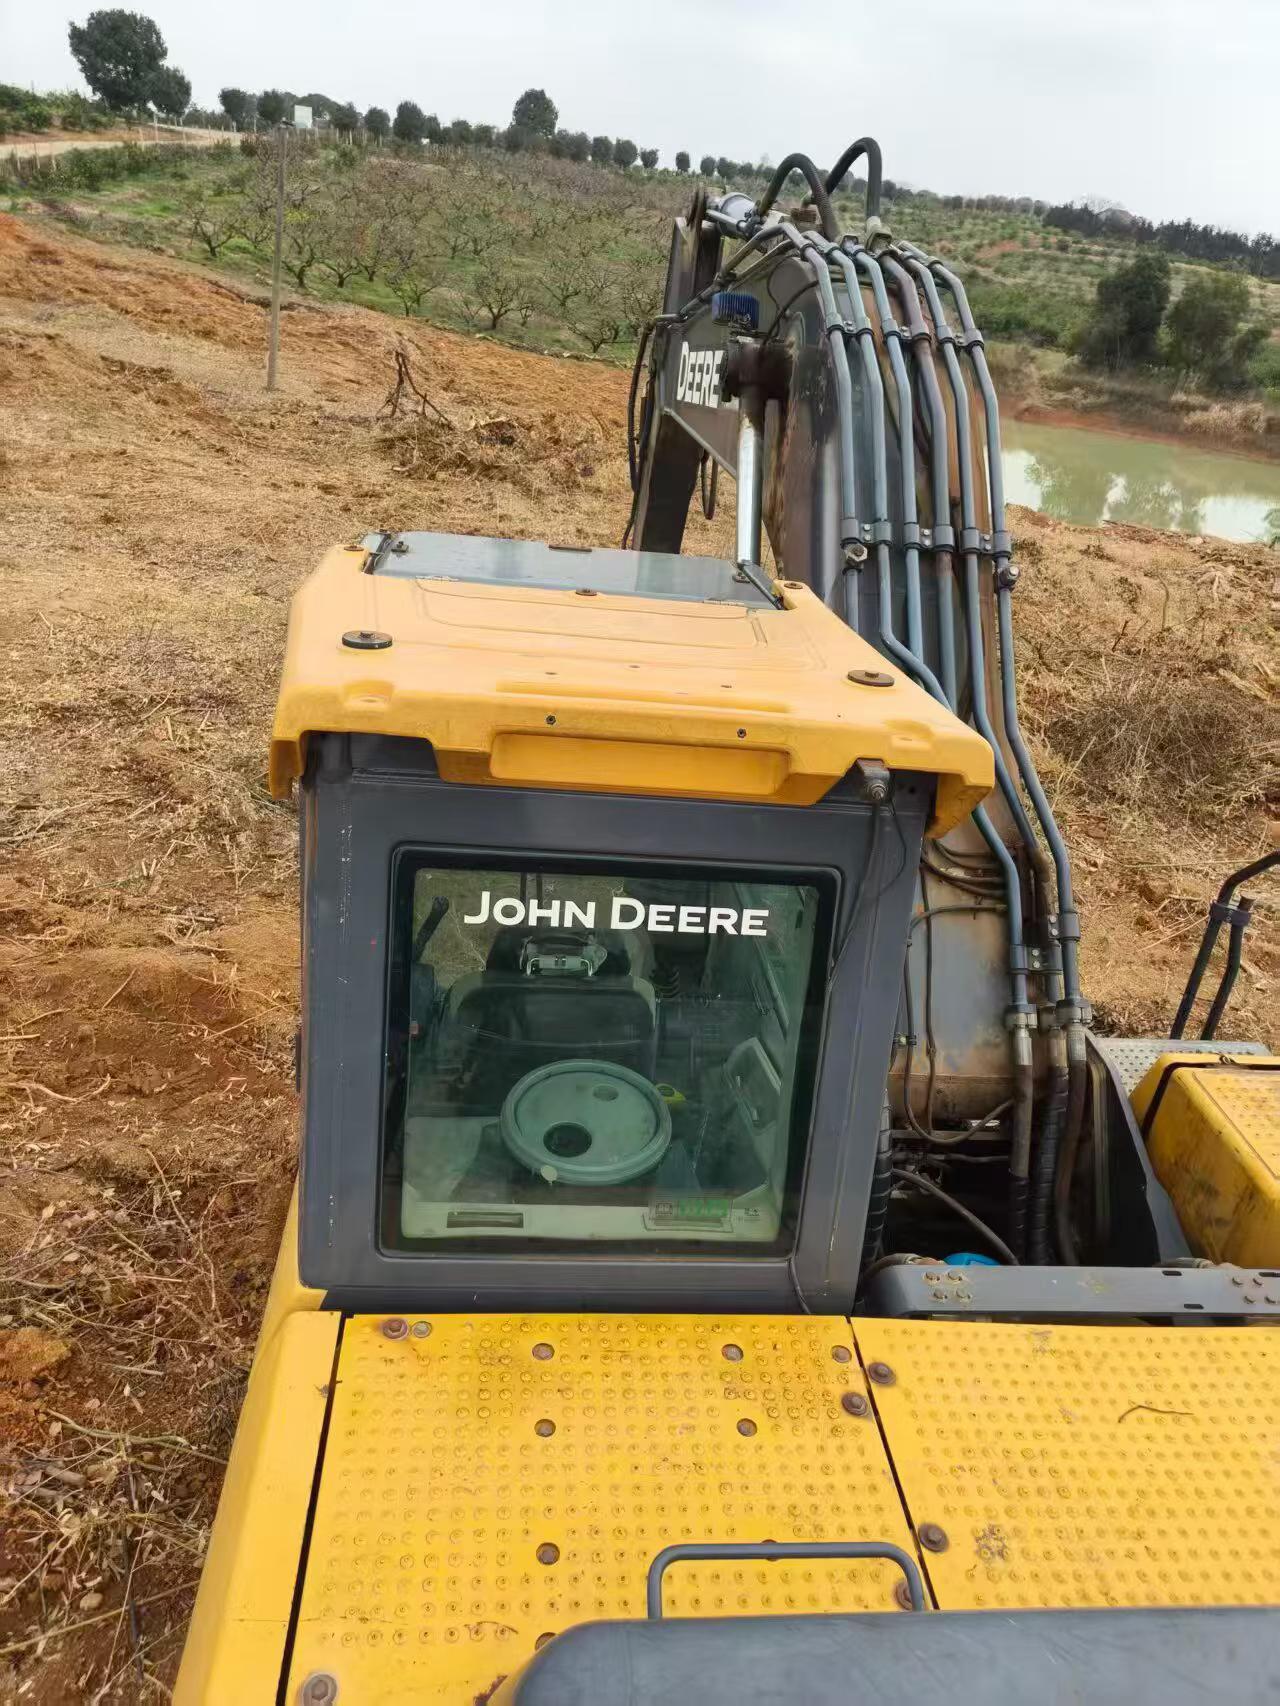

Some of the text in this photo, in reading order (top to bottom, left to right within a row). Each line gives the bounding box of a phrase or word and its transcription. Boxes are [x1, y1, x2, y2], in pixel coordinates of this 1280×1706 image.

[676, 341, 725, 409] DEERE
[463, 891, 770, 937] JOHN DEERE
